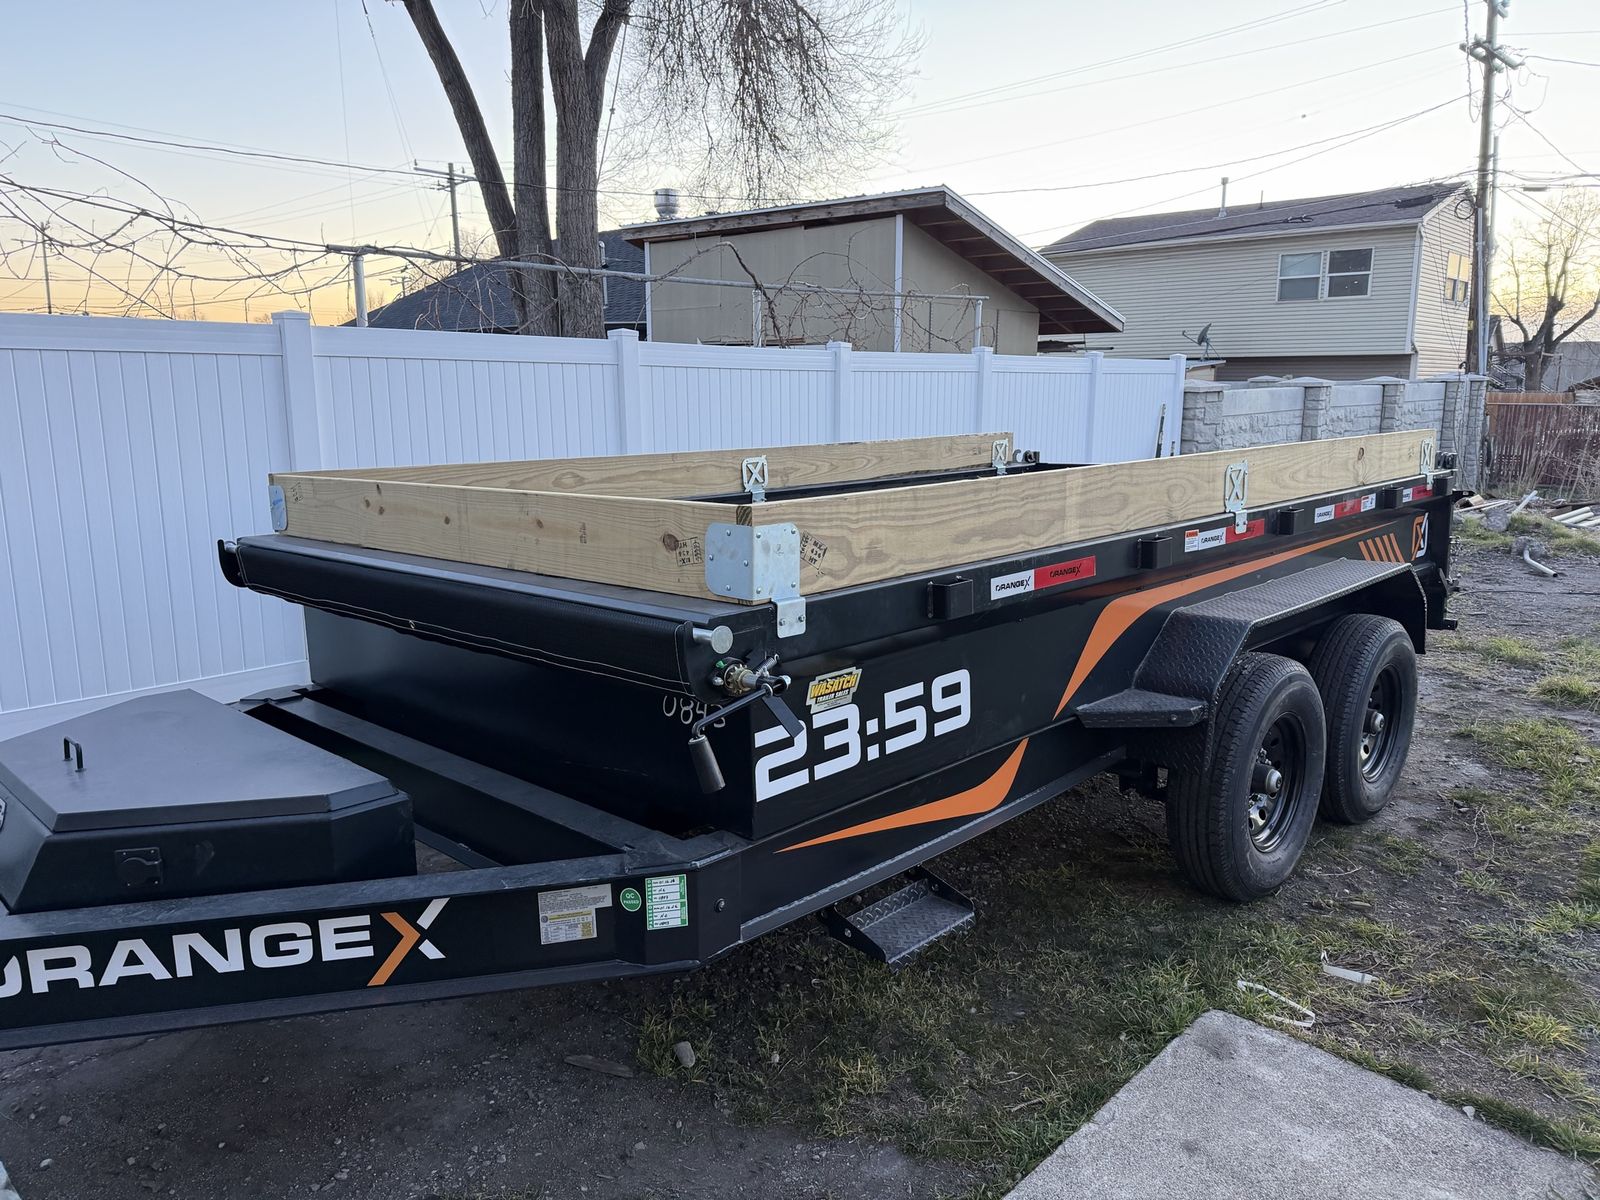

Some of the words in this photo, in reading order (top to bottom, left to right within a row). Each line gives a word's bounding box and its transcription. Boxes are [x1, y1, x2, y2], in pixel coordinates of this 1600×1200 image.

[1049, 563, 1082, 578] ORANGEX
[995, 576, 1031, 592] ORANGEX
[810, 673, 858, 698] WASATCH
[754, 668, 971, 803] 23:59
